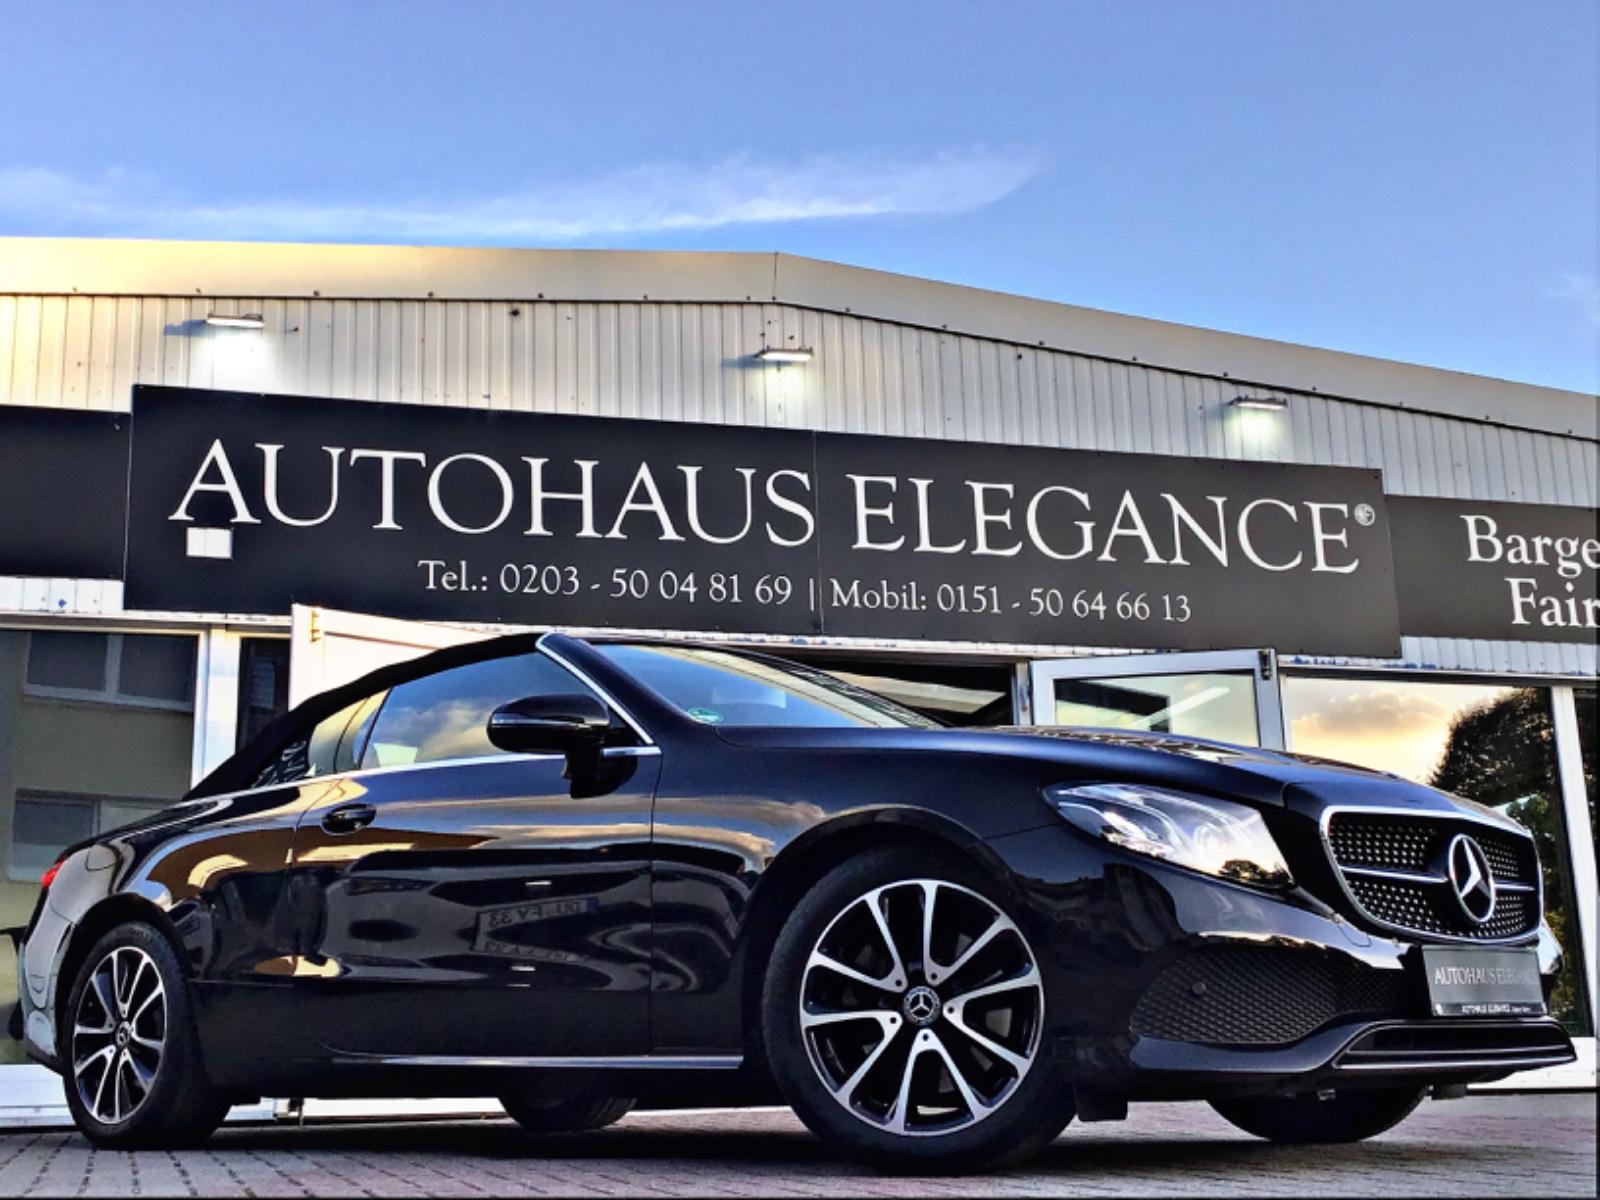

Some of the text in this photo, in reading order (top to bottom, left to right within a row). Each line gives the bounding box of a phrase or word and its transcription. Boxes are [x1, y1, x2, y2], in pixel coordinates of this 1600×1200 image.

[168, 439, 1360, 574] AUTOHAUS ELEGANCE
[1460, 514, 1600, 578] Barge
[417, 559, 488, 591] Tel.:
[499, 563, 580, 595] 0203
[610, 568, 649, 599] 50
[659, 570, 698, 602] 04
[709, 572, 742, 603] 81
[754, 574, 792, 605] 69
[829, 578, 927, 611] Mobil:
[936, 583, 1002, 614] 0151
[1029, 587, 1064, 617] 50
[1071, 589, 1107, 620] 64
[1116, 591, 1151, 621] 66
[1162, 593, 1191, 623] 13
[1504, 577, 1600, 628] Fair
